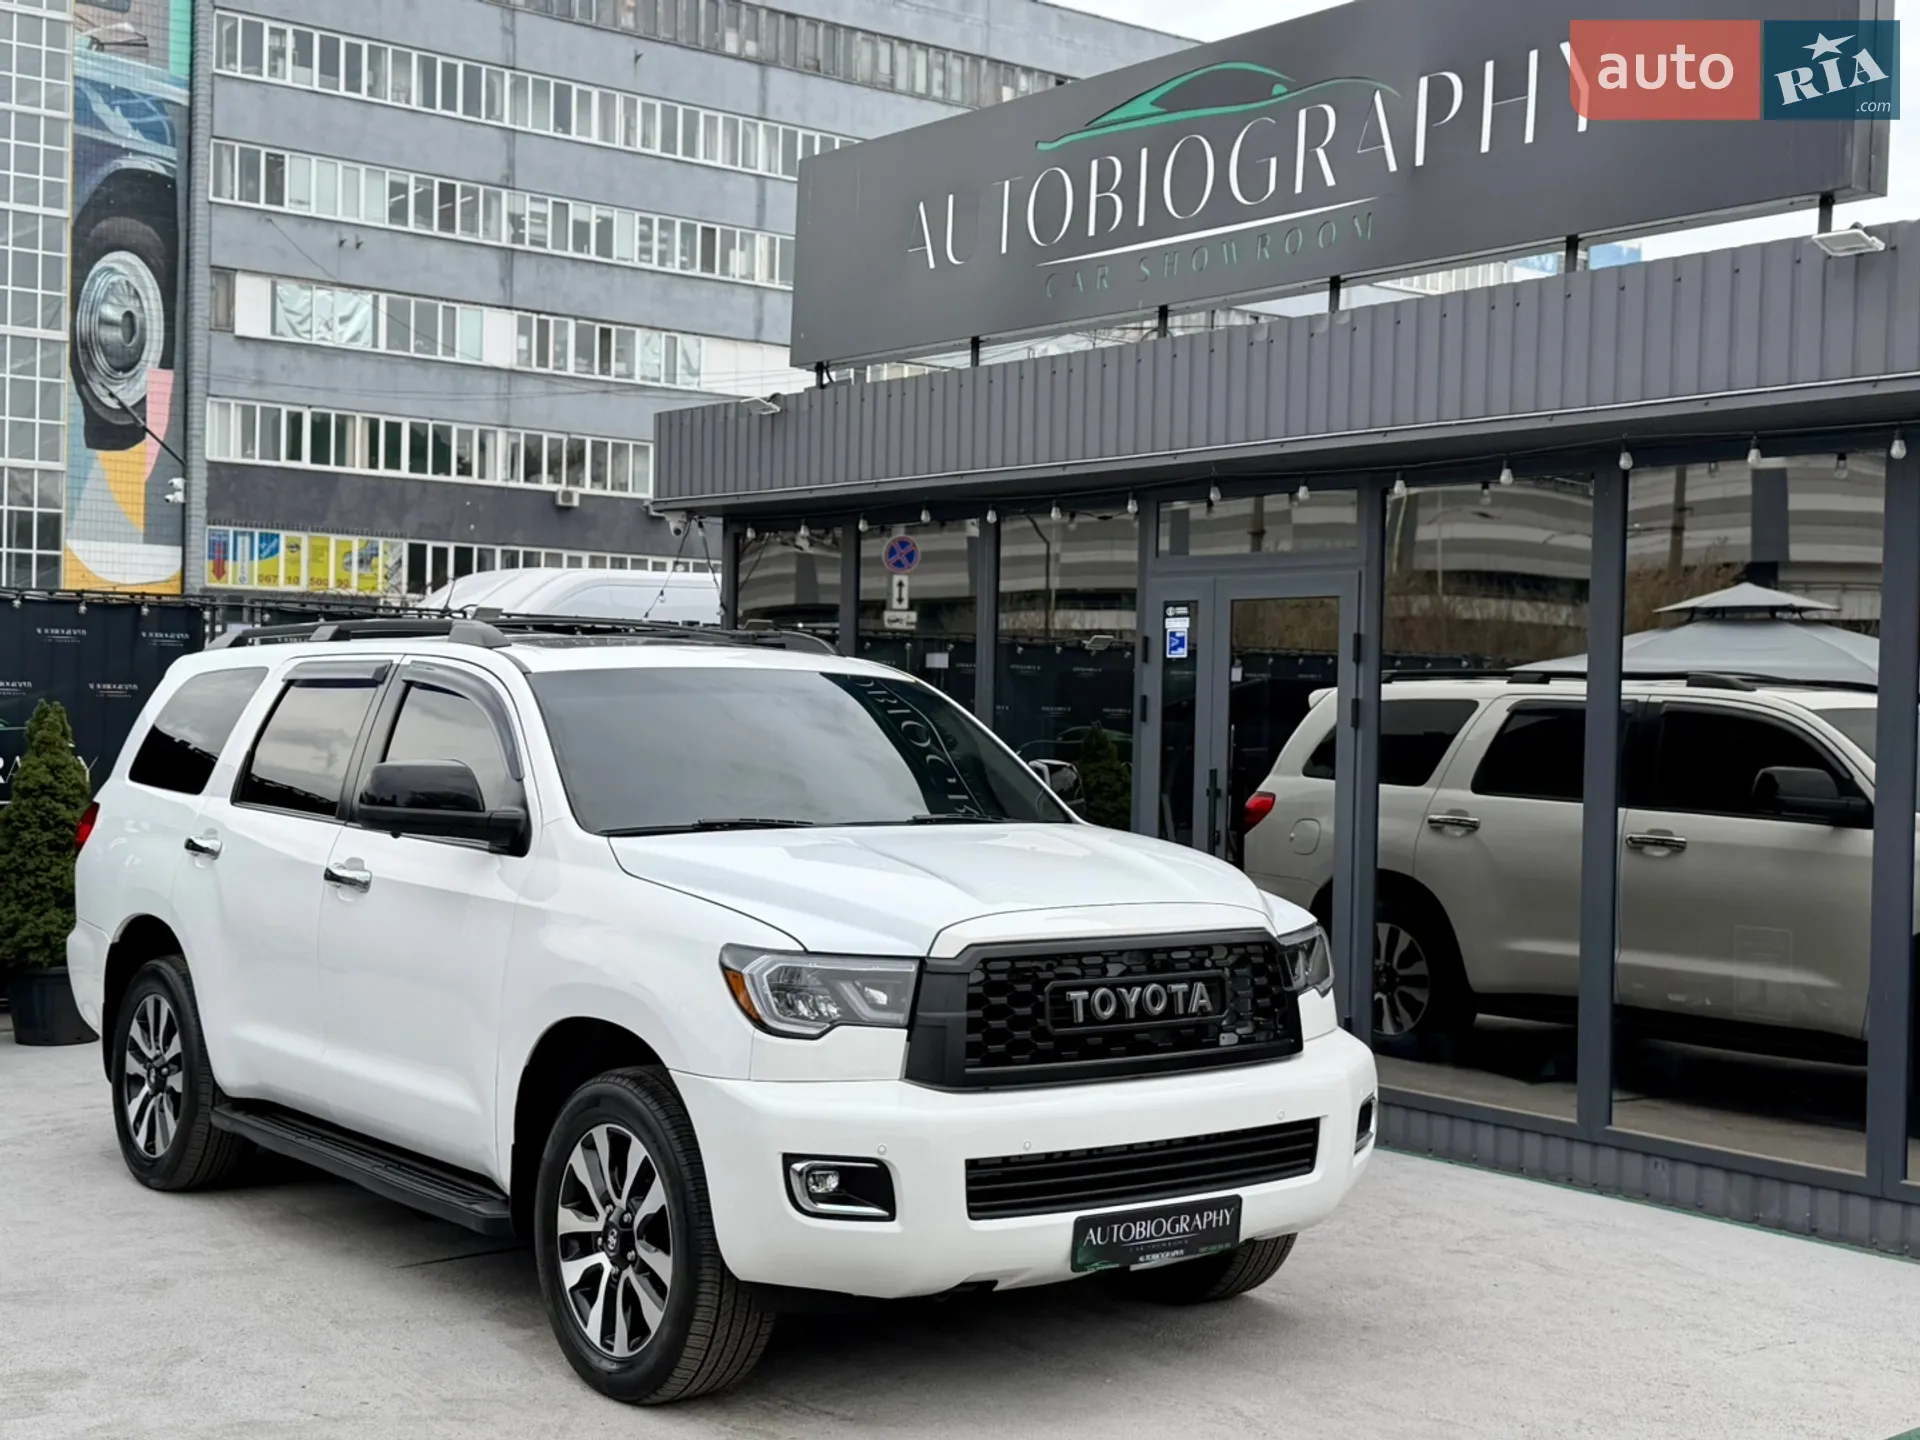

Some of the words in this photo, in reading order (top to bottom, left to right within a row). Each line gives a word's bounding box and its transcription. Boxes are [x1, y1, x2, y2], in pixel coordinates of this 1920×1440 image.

[908, 40, 1596, 269] AUTOBIOGRAPHY
[1044, 264, 1109, 298] CAR
[1138, 211, 1373, 283] SHOWROOM
[1066, 981, 1213, 1024] TOYOTA
[1083, 1207, 1234, 1246] AUTOBIOGRAPHY
